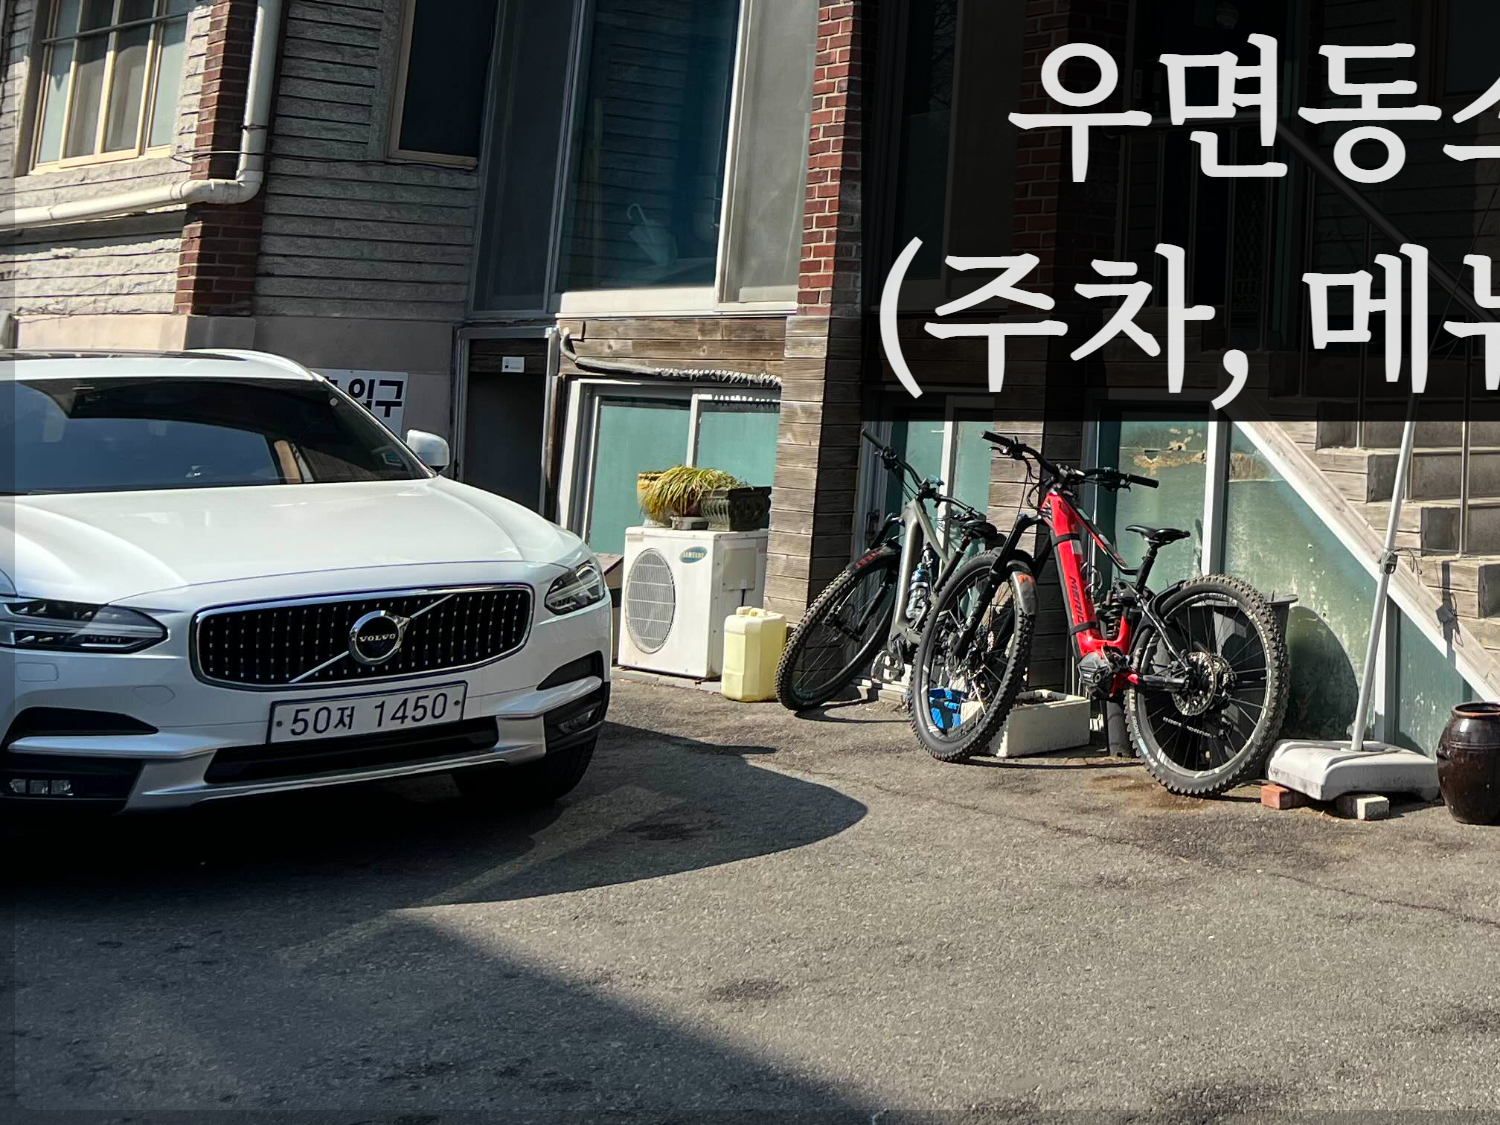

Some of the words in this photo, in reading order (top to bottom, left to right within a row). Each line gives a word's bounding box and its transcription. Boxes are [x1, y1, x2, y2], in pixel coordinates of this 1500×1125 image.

[359, 632, 396, 644] VOLVO
[290, 706, 356, 736] 50저
[374, 692, 448, 728] 1450
